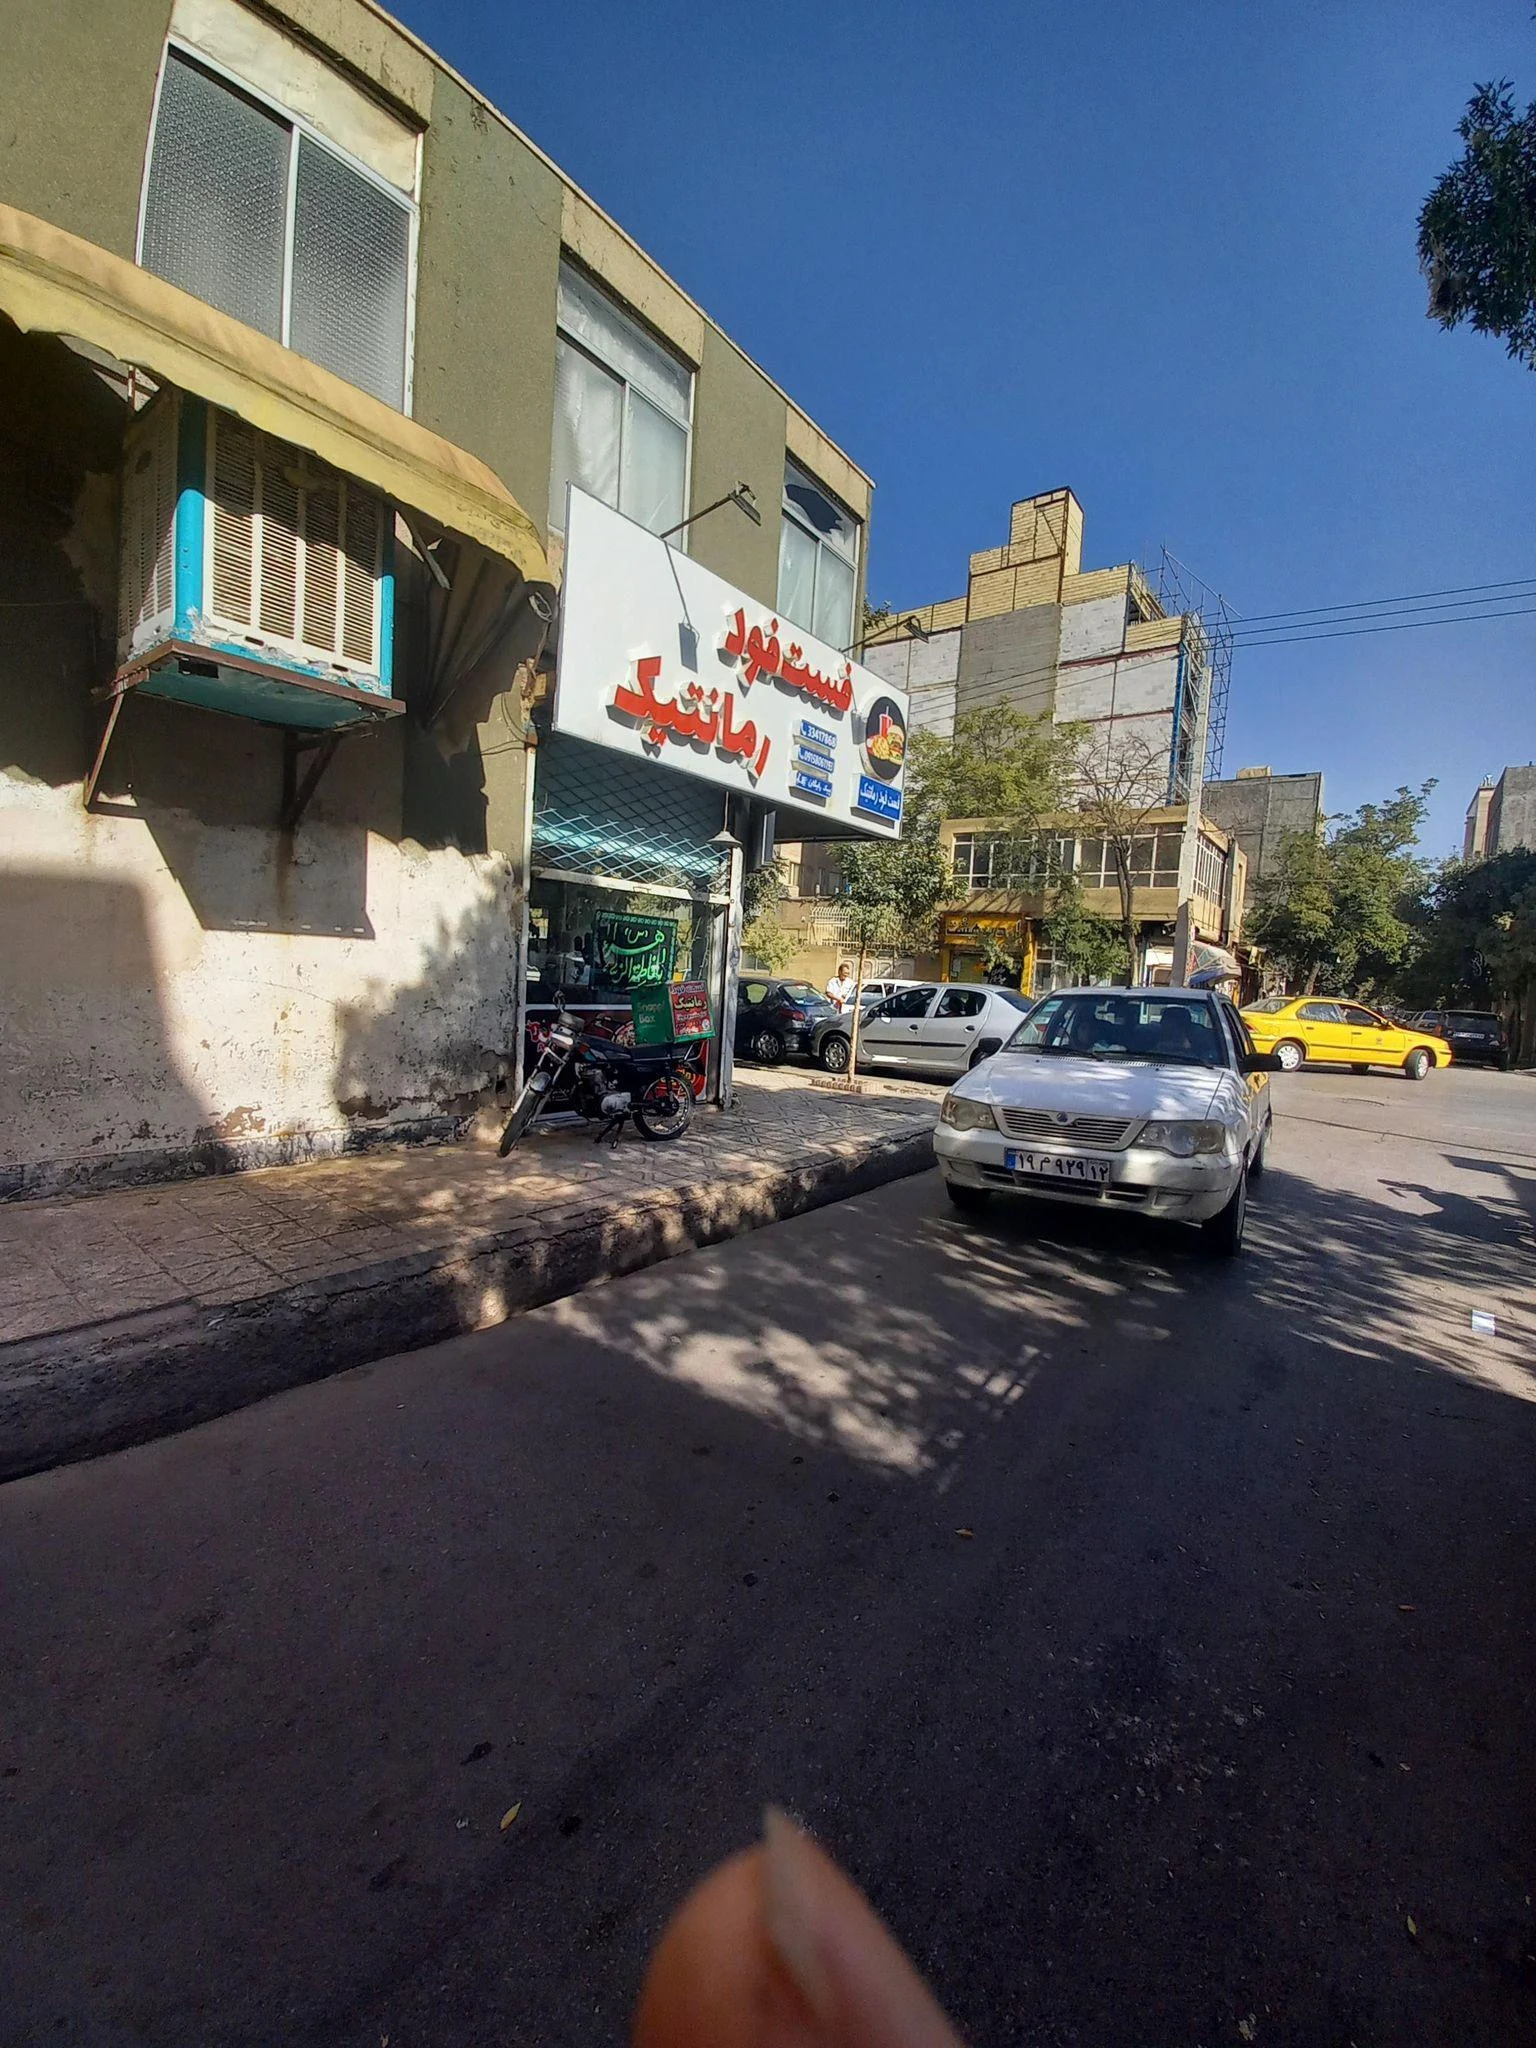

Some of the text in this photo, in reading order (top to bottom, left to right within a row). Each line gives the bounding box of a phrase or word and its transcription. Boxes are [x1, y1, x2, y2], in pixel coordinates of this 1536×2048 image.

[725, 607, 852, 711] فست فود
[613, 656, 771, 778] رمانتیک
